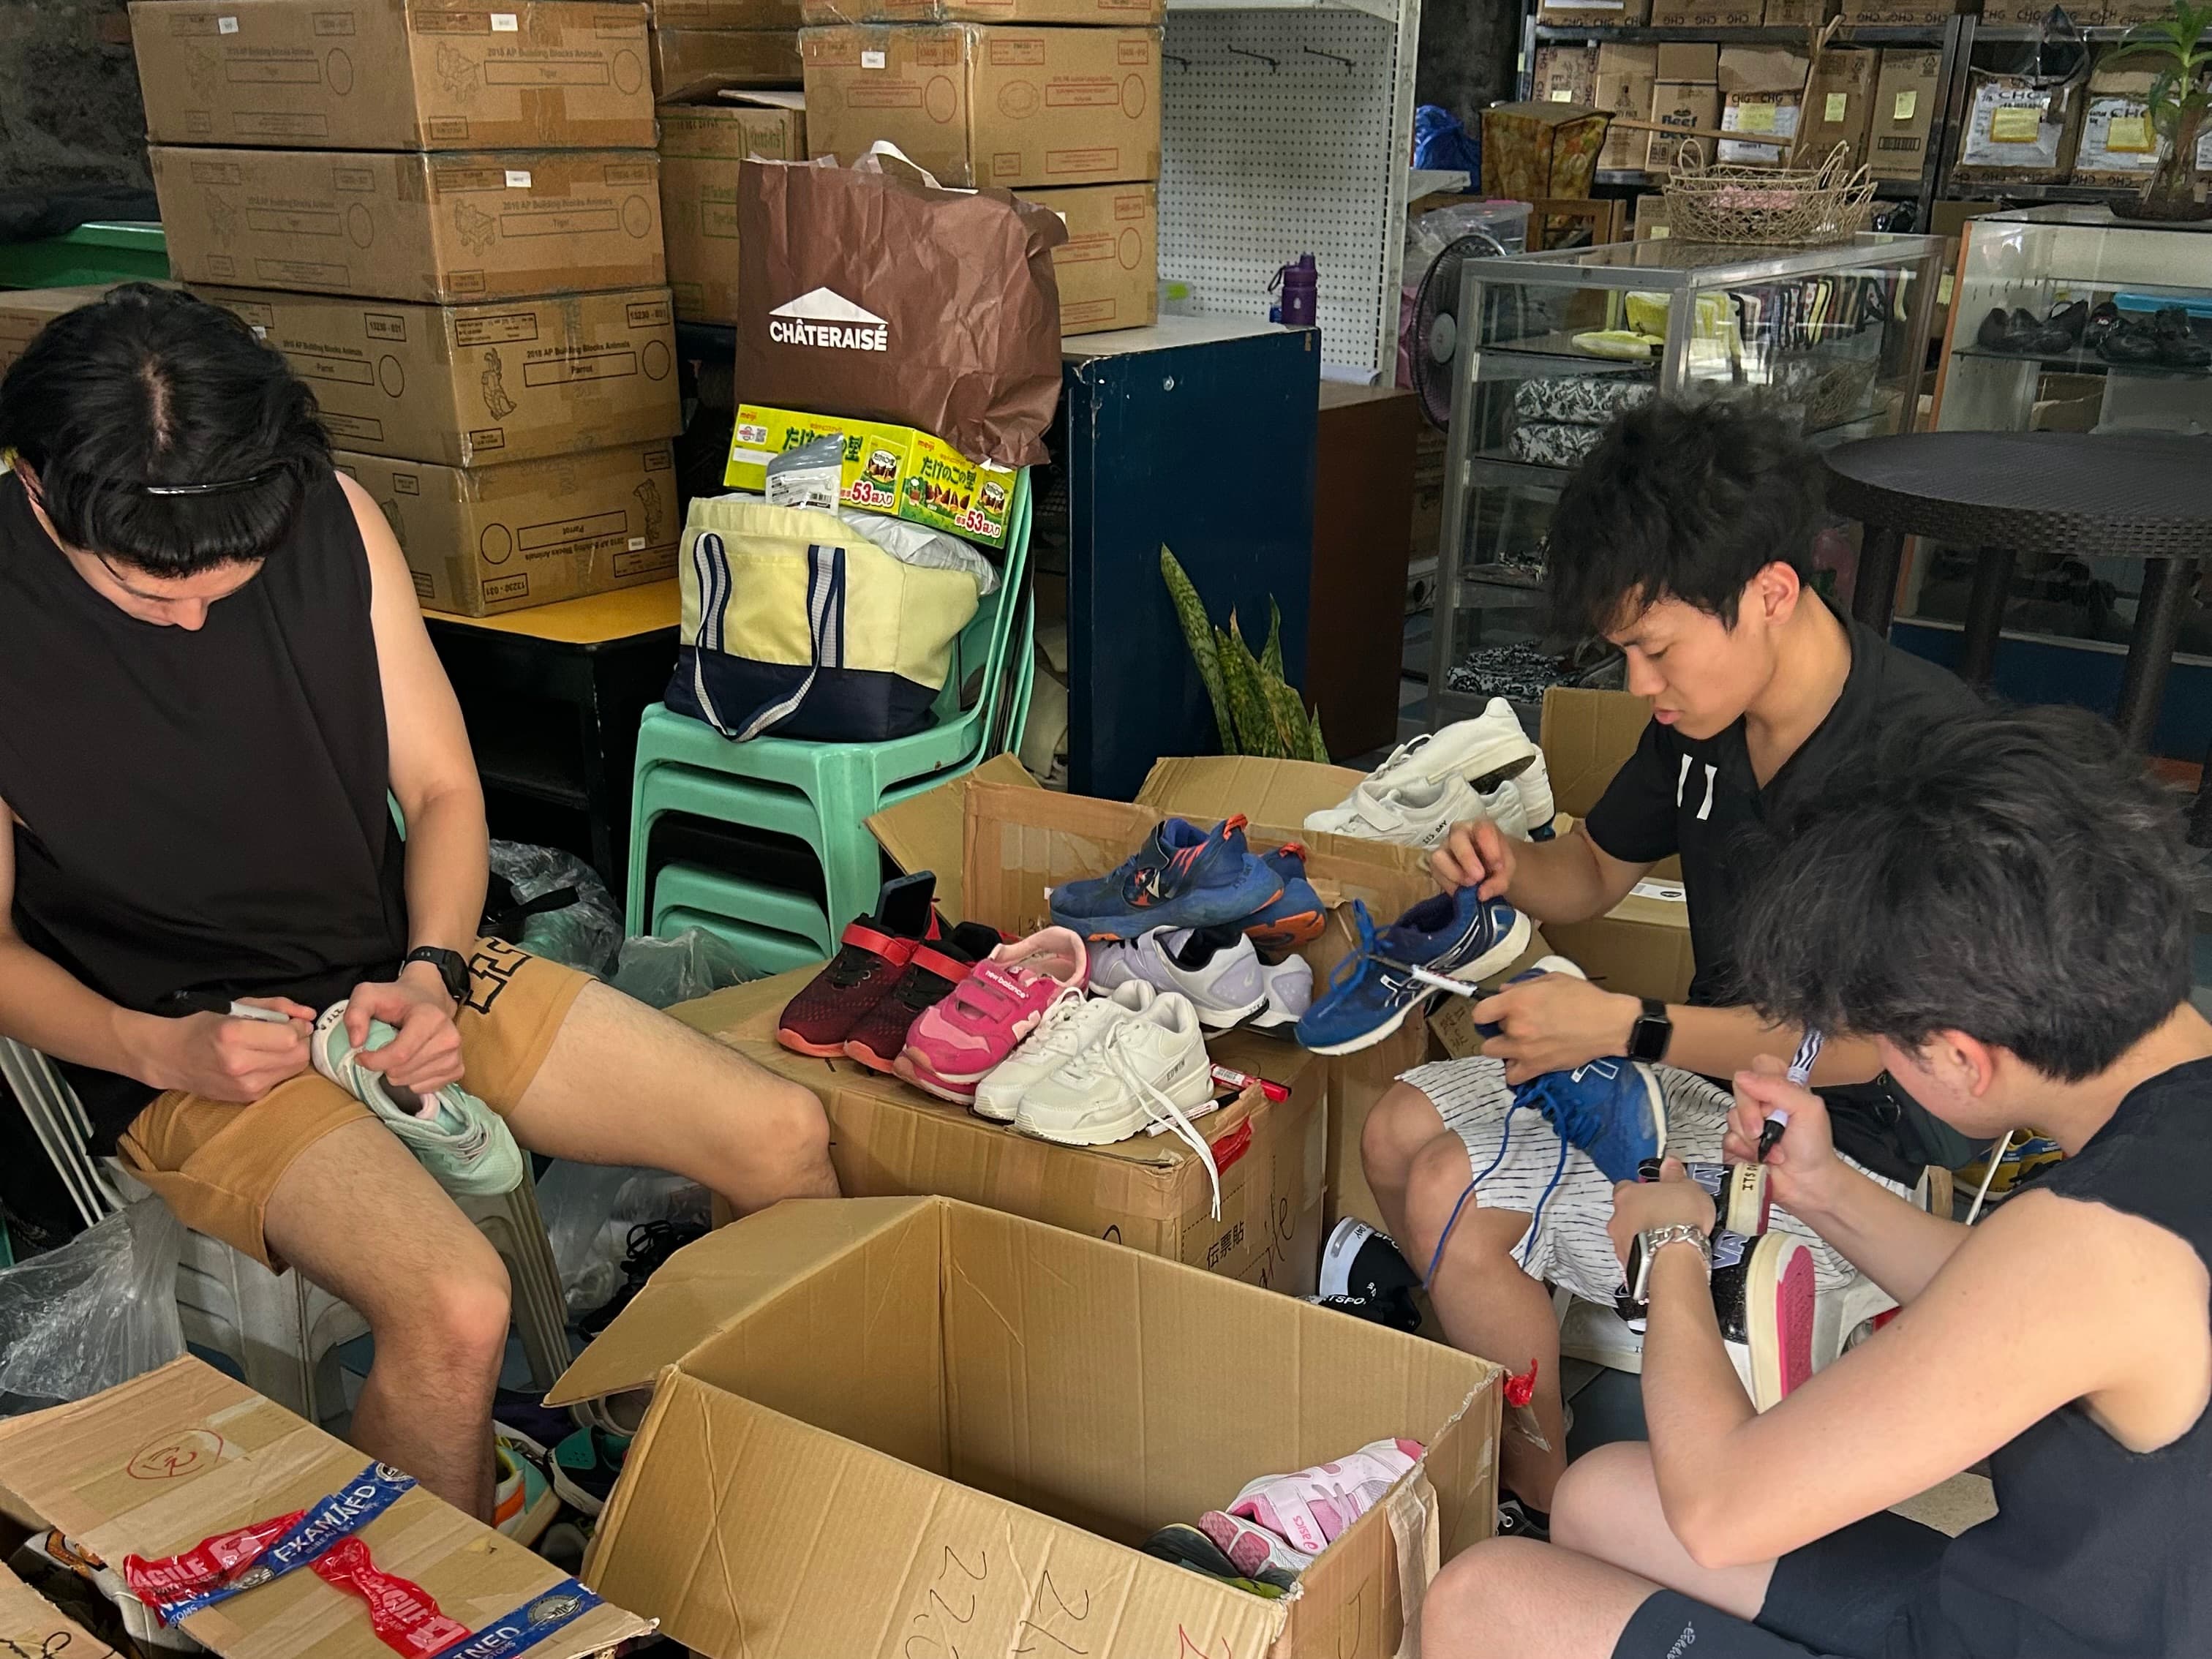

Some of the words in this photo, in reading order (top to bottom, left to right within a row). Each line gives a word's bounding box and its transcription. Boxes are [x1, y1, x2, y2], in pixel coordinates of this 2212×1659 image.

[769, 318, 888, 352] CHÂTERAISÉ
[543, 347, 554, 357] AP
[583, 343, 604, 353] Blocks
[606, 341, 631, 350] Animals
[571, 364, 593, 375] Parrot
[917, 439, 936, 451] meiji
[919, 456, 977, 492] たけのこの里
[563, 524, 584, 535] Parrot
[525, 551, 550, 562] Animals
[998, 976, 1026, 999] balance
[1166, 1058, 1186, 1082] EDWIN
[1742, 1172, 1757, 1191] ITS
[1206, 1219, 1244, 1271] 伝票貼
[1293, 1515, 1312, 1540] asics
